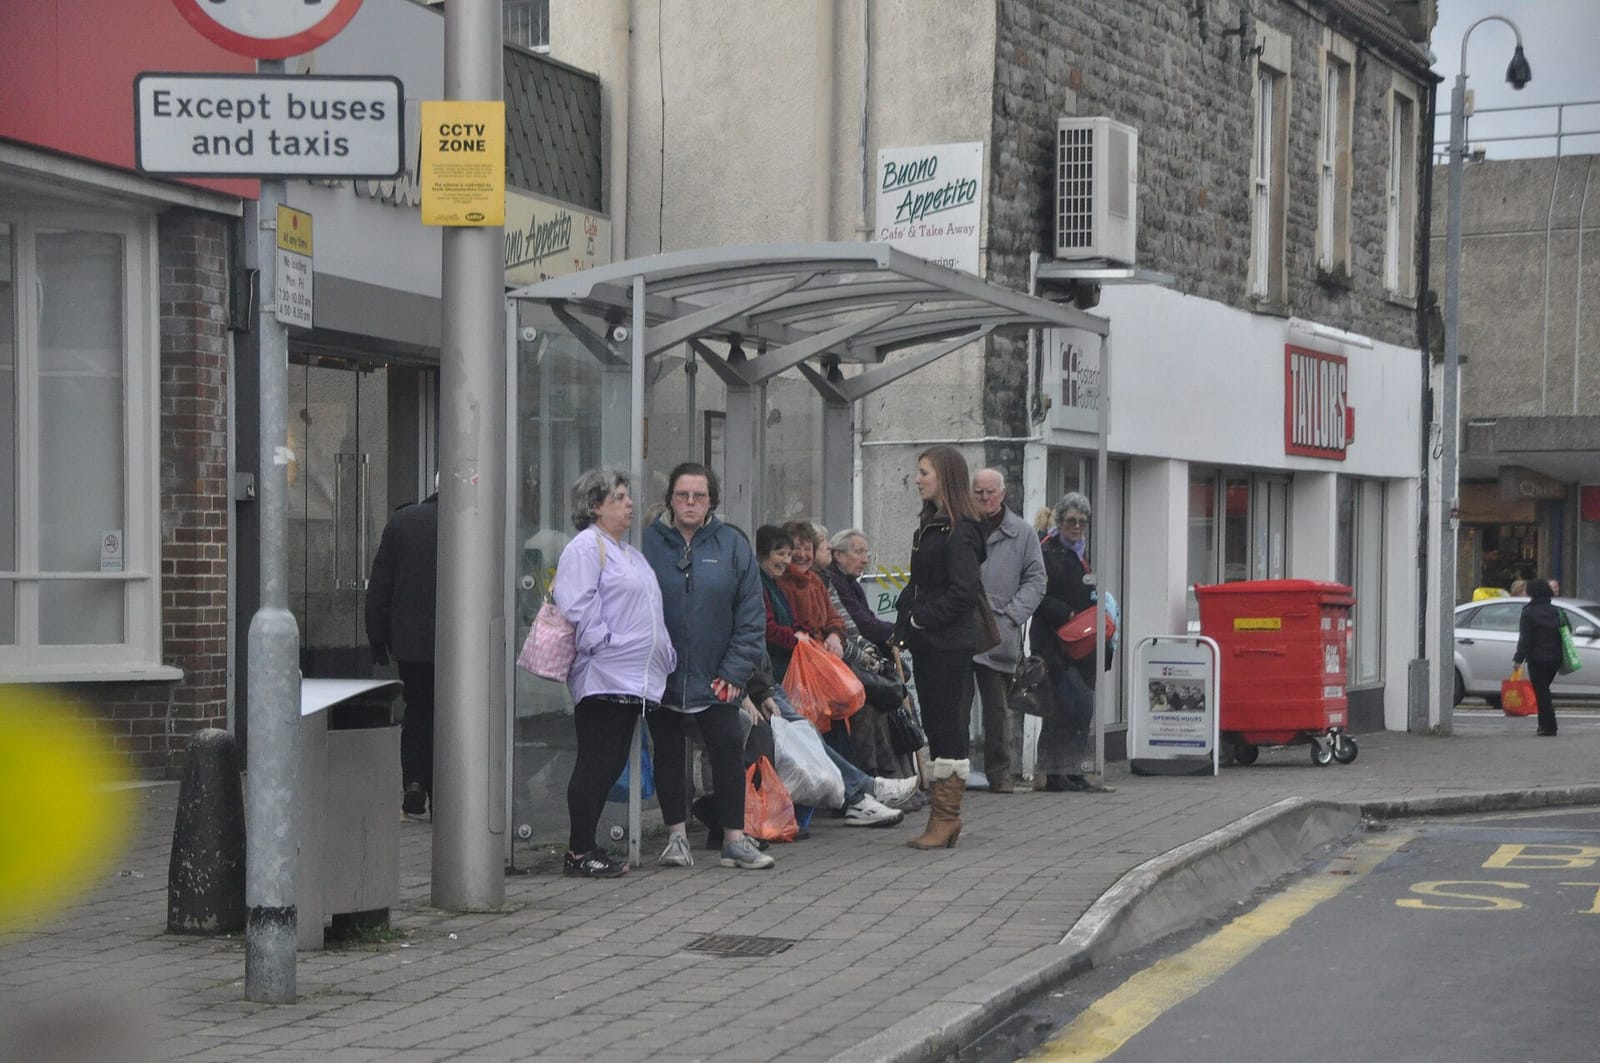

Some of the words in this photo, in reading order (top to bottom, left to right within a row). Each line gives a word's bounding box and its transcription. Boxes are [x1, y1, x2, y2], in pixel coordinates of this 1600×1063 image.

[153, 90, 271, 124] Except
[287, 93, 386, 121] buses
[191, 129, 254, 156] and
[268, 130, 350, 157] taxis
[438, 139, 486, 152] ZONE
[439, 124, 486, 137] CCTV
[882, 155, 938, 190] Buono
[895, 177, 978, 224] Appetito
[505, 229, 523, 265] ono
[525, 208, 572, 269] Appetito
[908, 226, 917, 238] &
[919, 224, 944, 238] Take
[946, 222, 975, 237] Away
[1290, 352, 1346, 451] TAYLORS
